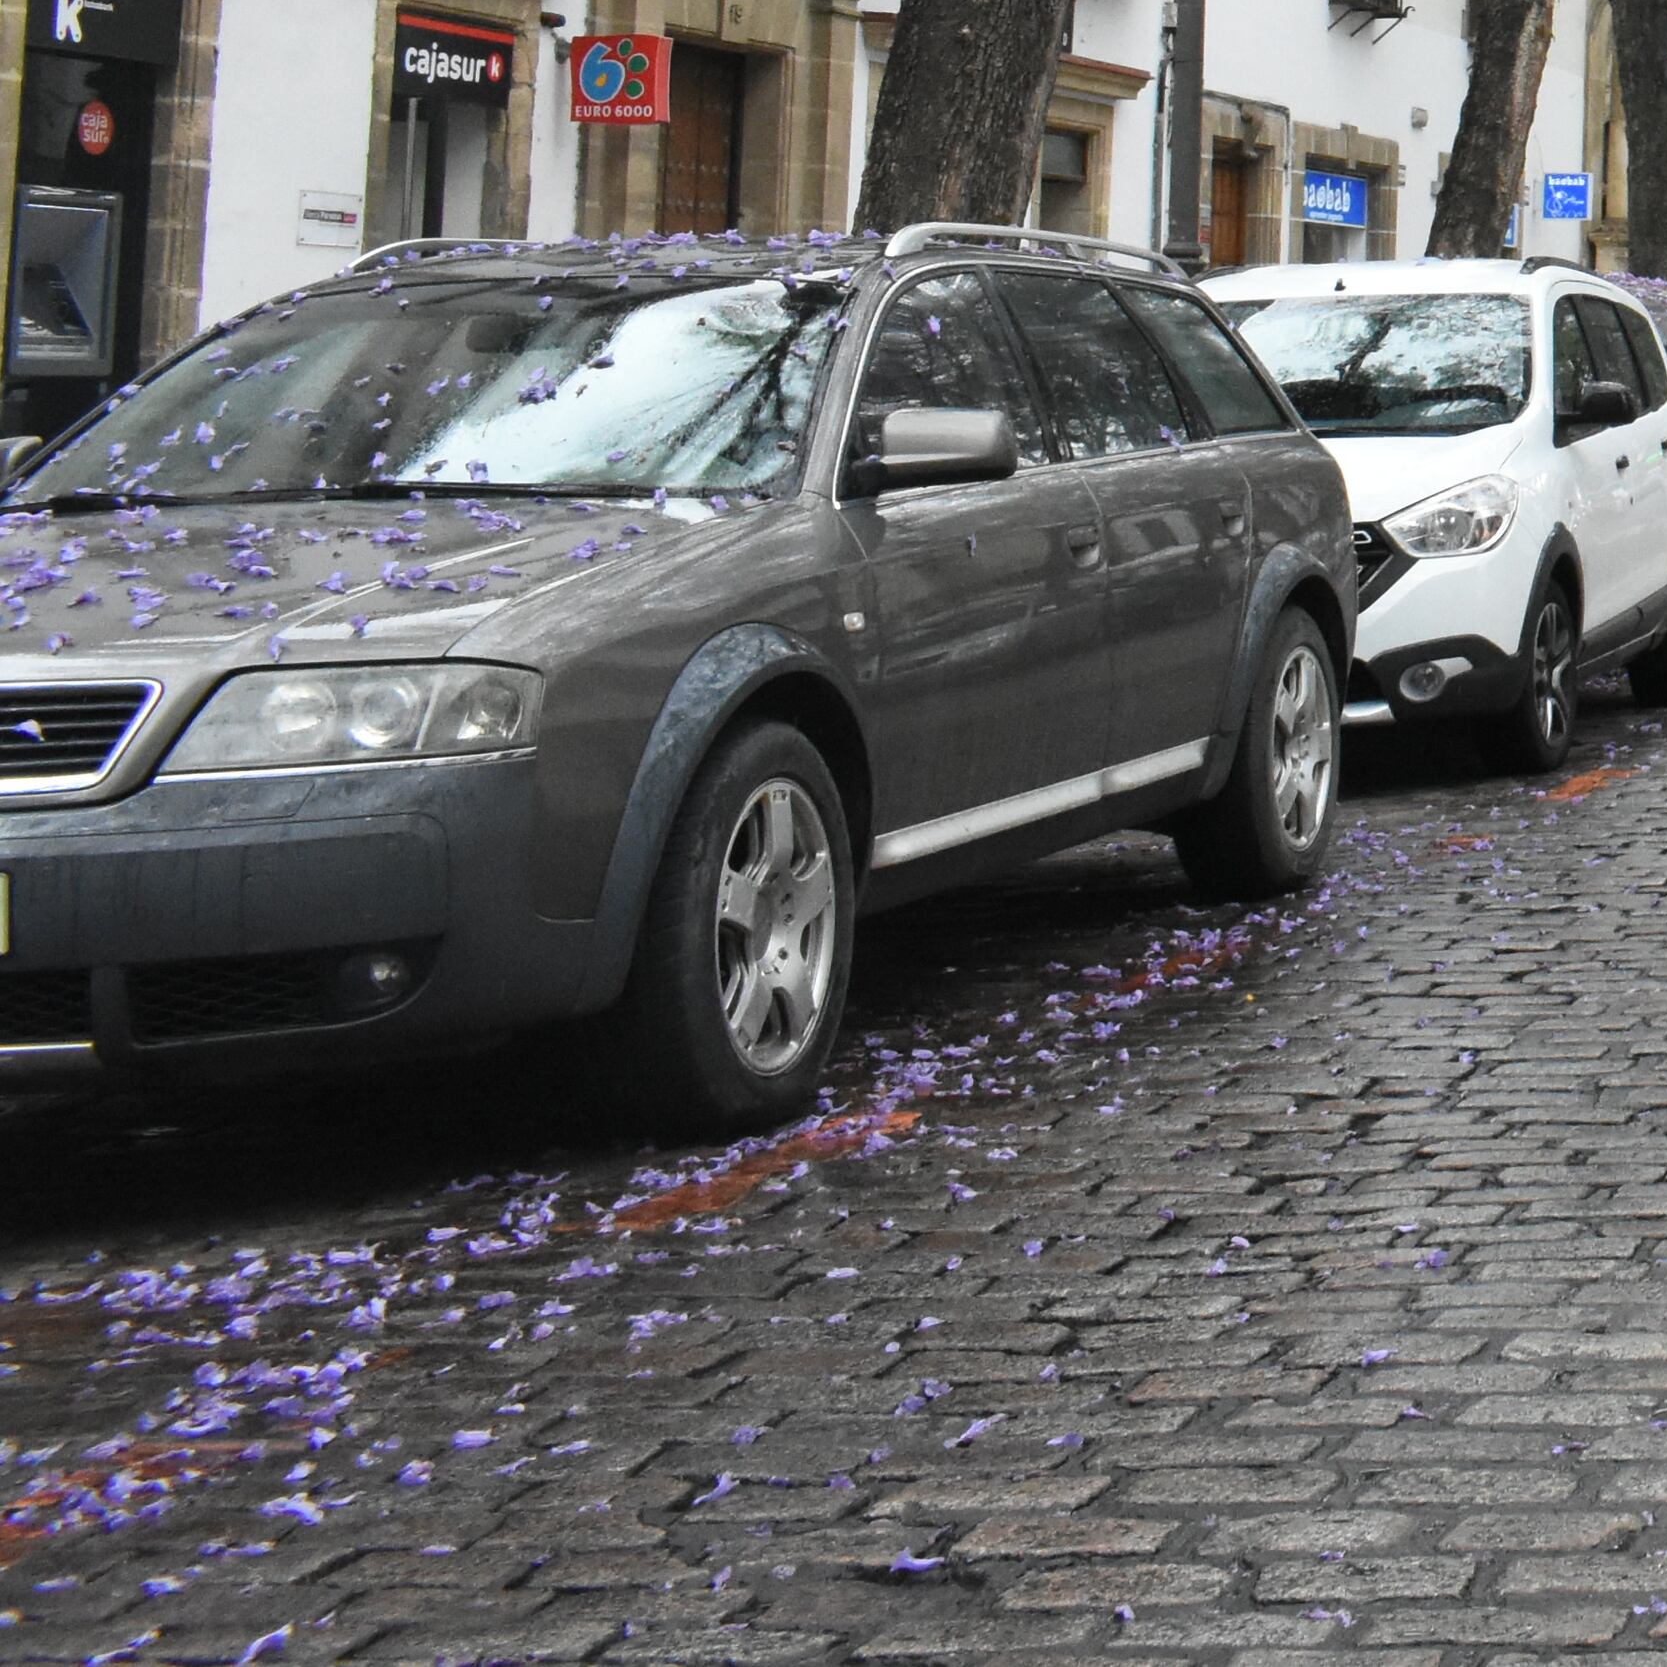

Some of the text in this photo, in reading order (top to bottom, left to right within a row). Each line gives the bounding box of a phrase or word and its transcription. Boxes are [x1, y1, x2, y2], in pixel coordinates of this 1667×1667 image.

[404, 42, 486, 83] cajasur
[81, 109, 108, 128] caja
[575, 104, 653, 118] EURO 6000
[1548, 175, 1586, 186] baobab
